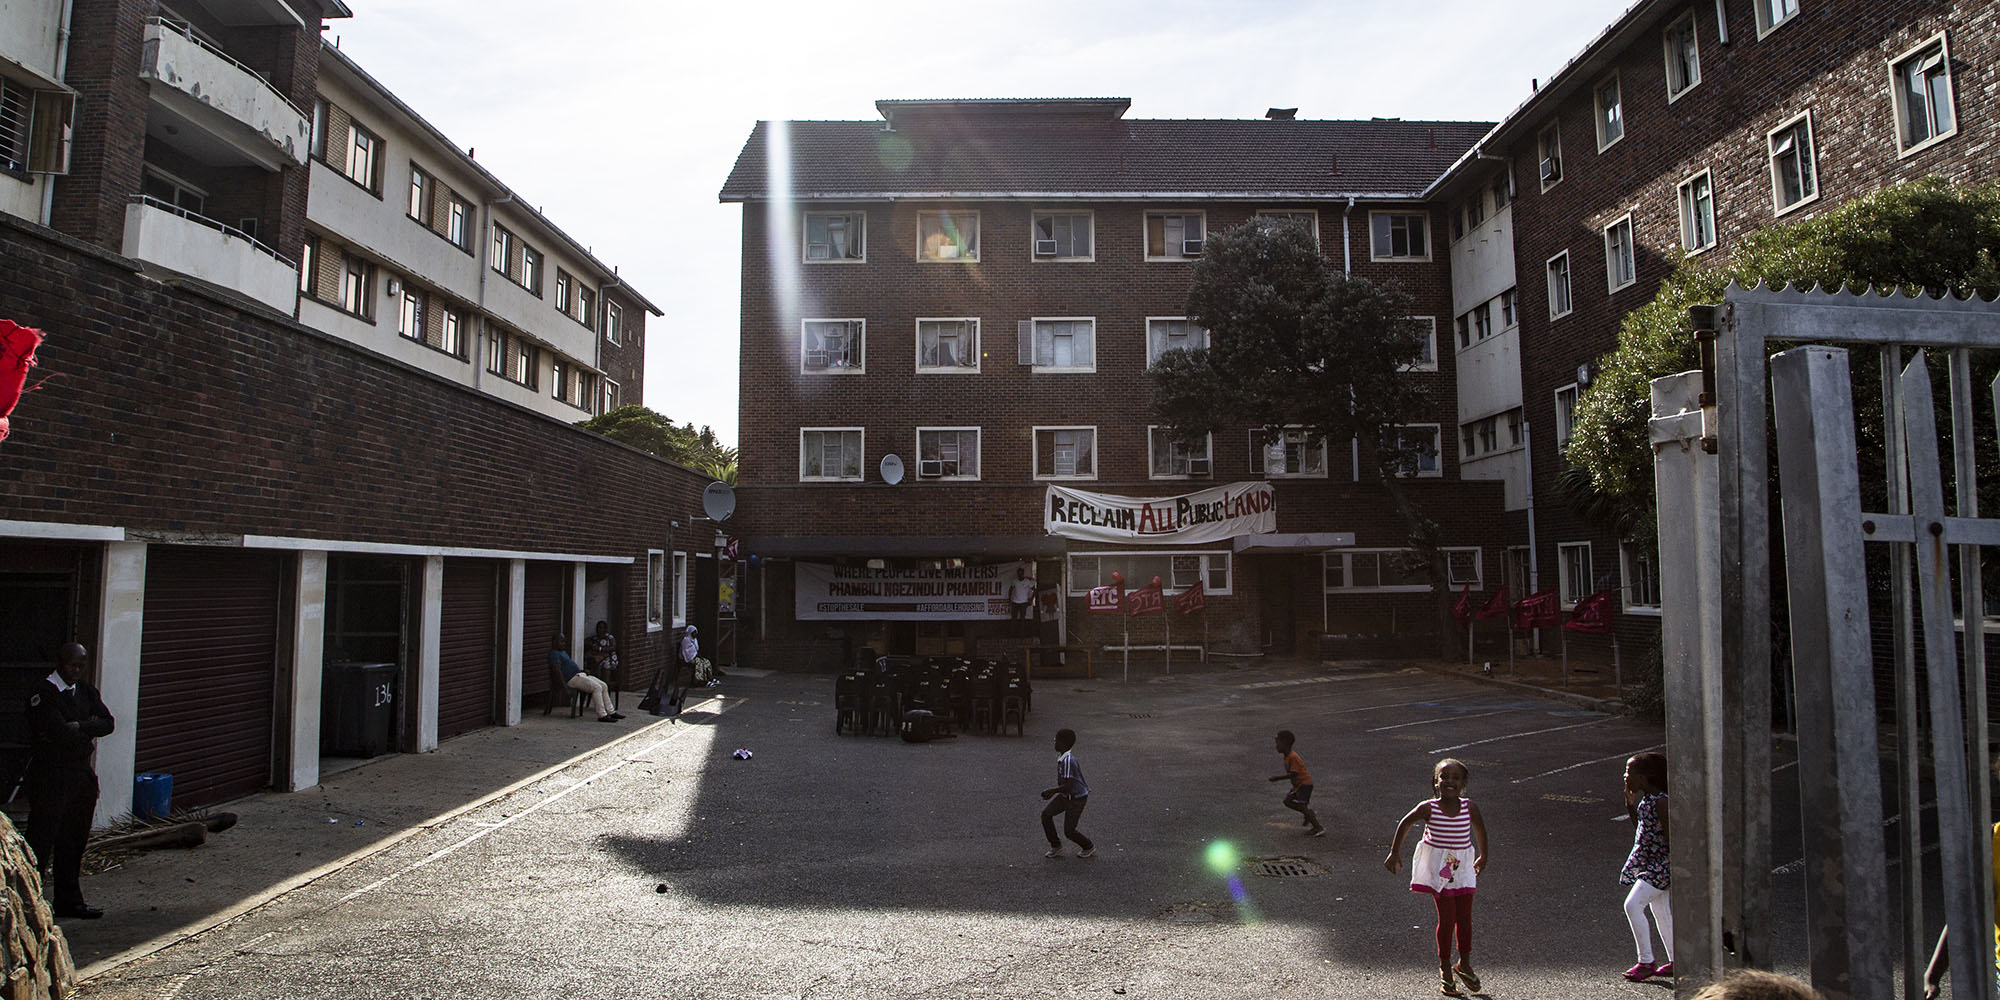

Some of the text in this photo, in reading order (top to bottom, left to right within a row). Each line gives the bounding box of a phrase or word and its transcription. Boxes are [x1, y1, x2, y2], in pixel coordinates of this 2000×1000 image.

[1051, 490, 1275, 532] RECLAIM ALL PUBLIC LAND!
[833, 565, 873, 579] WHERE
[875, 567, 915, 579] PEOPLE
[919, 567, 941, 579] LIVE
[829, 582, 881, 596] PHAMBILI
[884, 582, 944, 596] NGEZINDLU
[1090, 587, 1119, 606] RTC
[818, 603, 865, 612] #STOPTHESALE
[374, 682, 392, 707] 136
